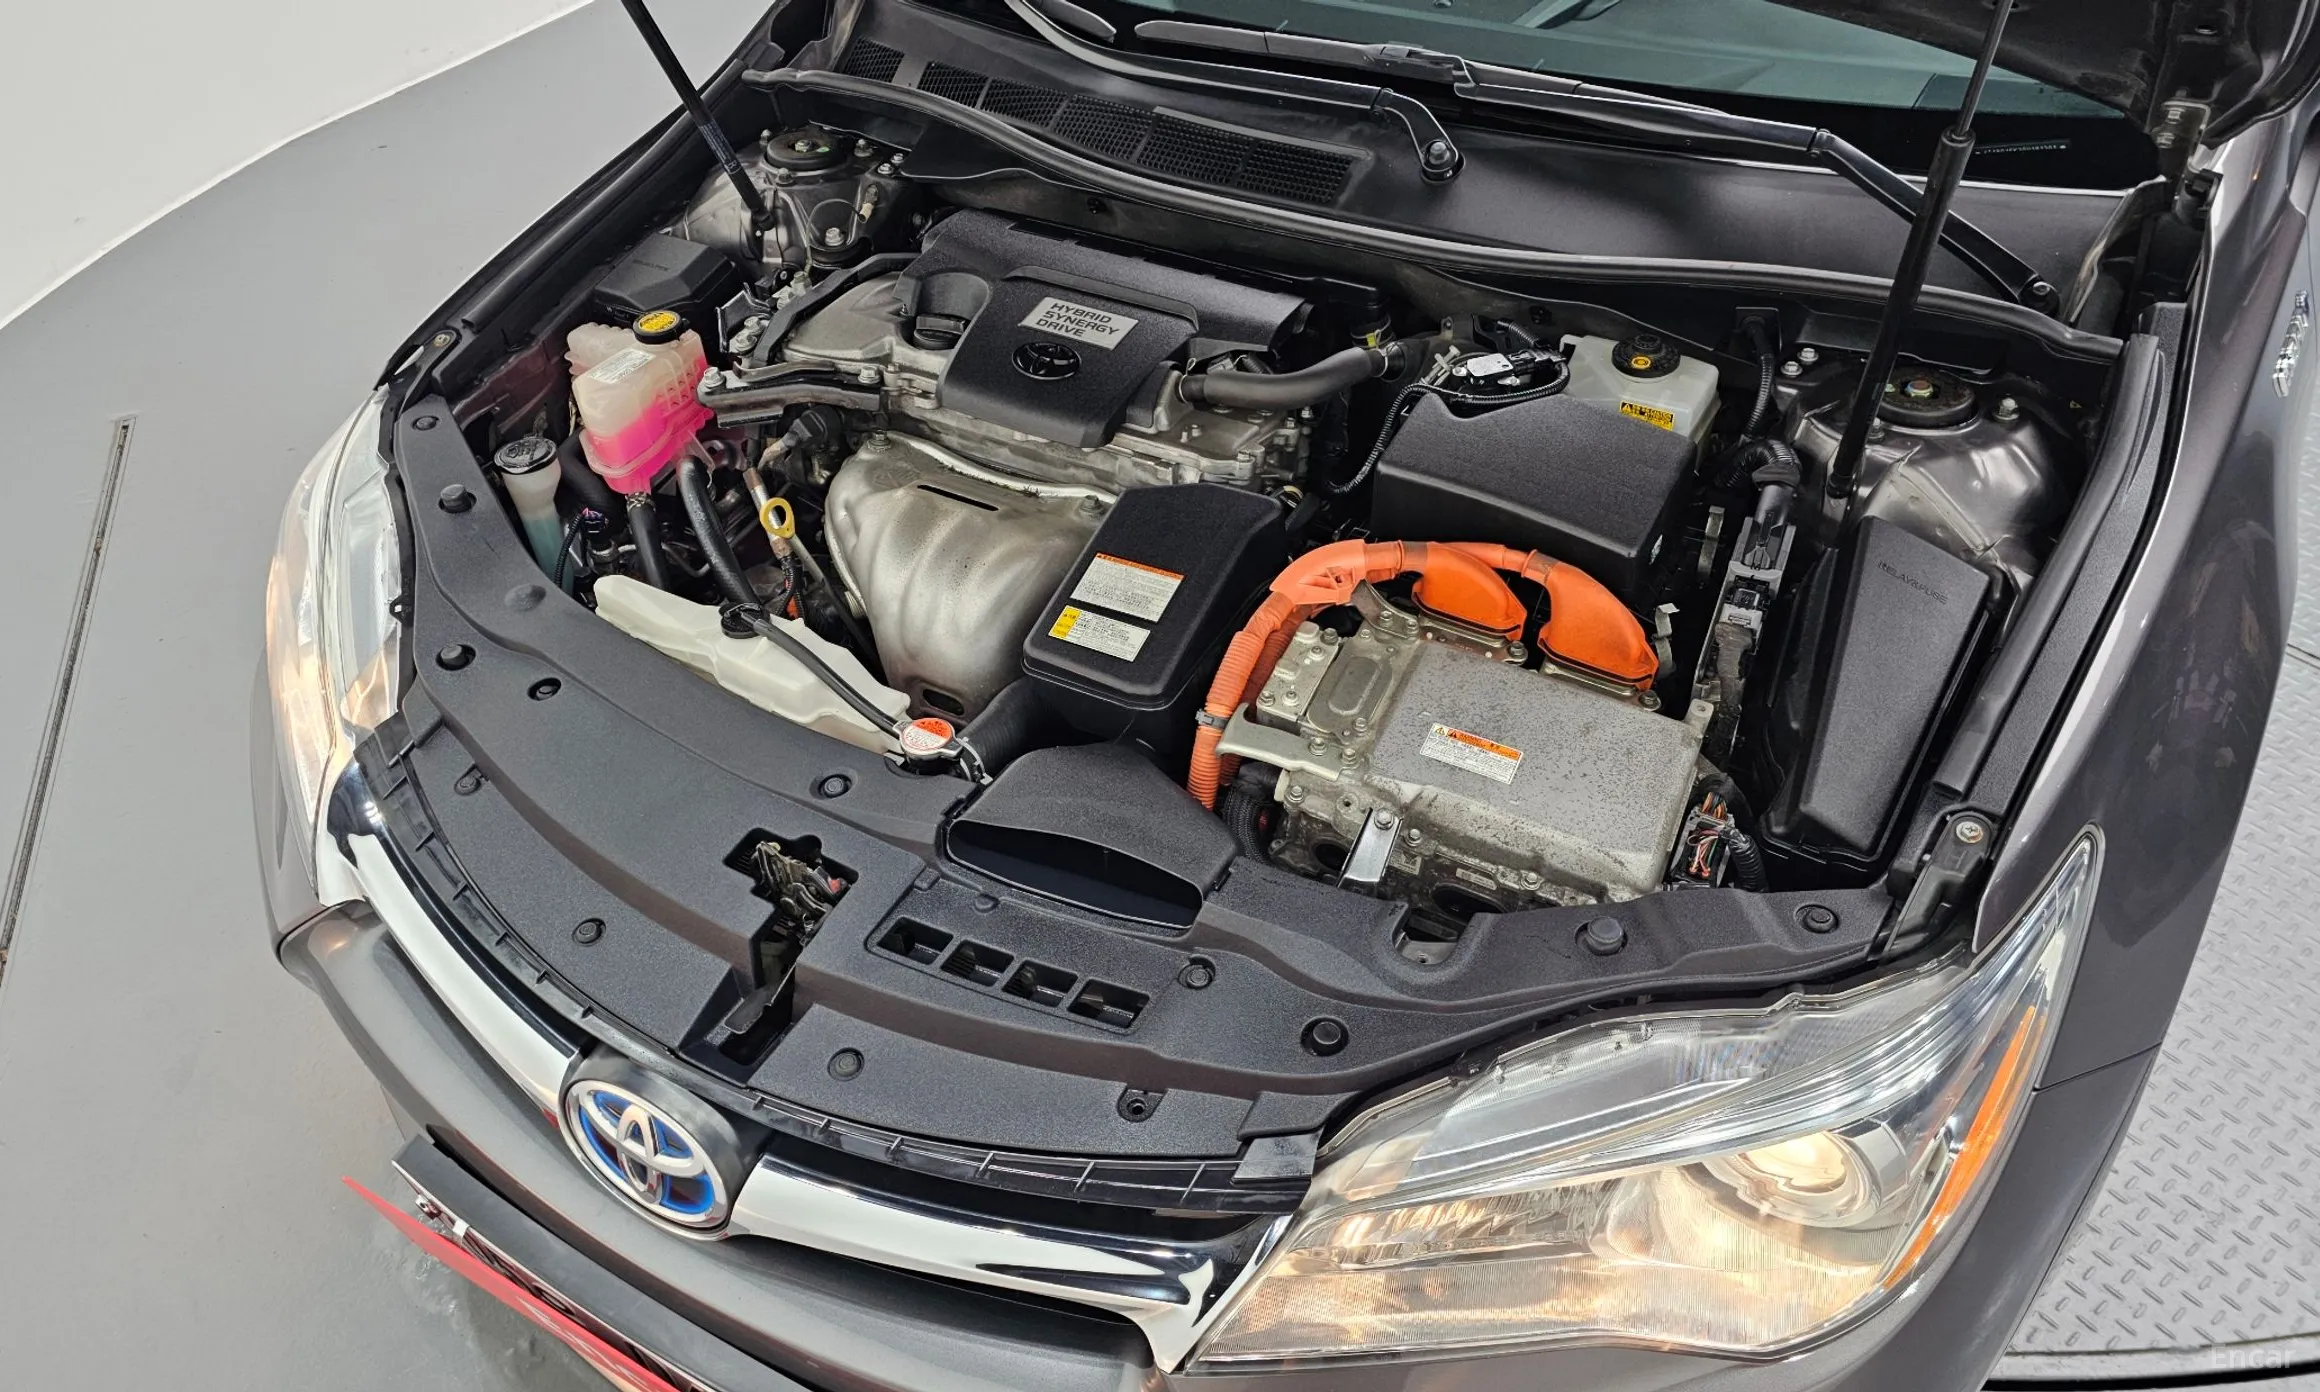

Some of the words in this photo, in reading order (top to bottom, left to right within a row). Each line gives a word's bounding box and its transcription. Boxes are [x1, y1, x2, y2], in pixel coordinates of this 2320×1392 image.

[1044, 311, 1119, 335] SYNERGY
[1051, 303, 1111, 323] HYBRID
[1036, 318, 1086, 335] DRIVE
